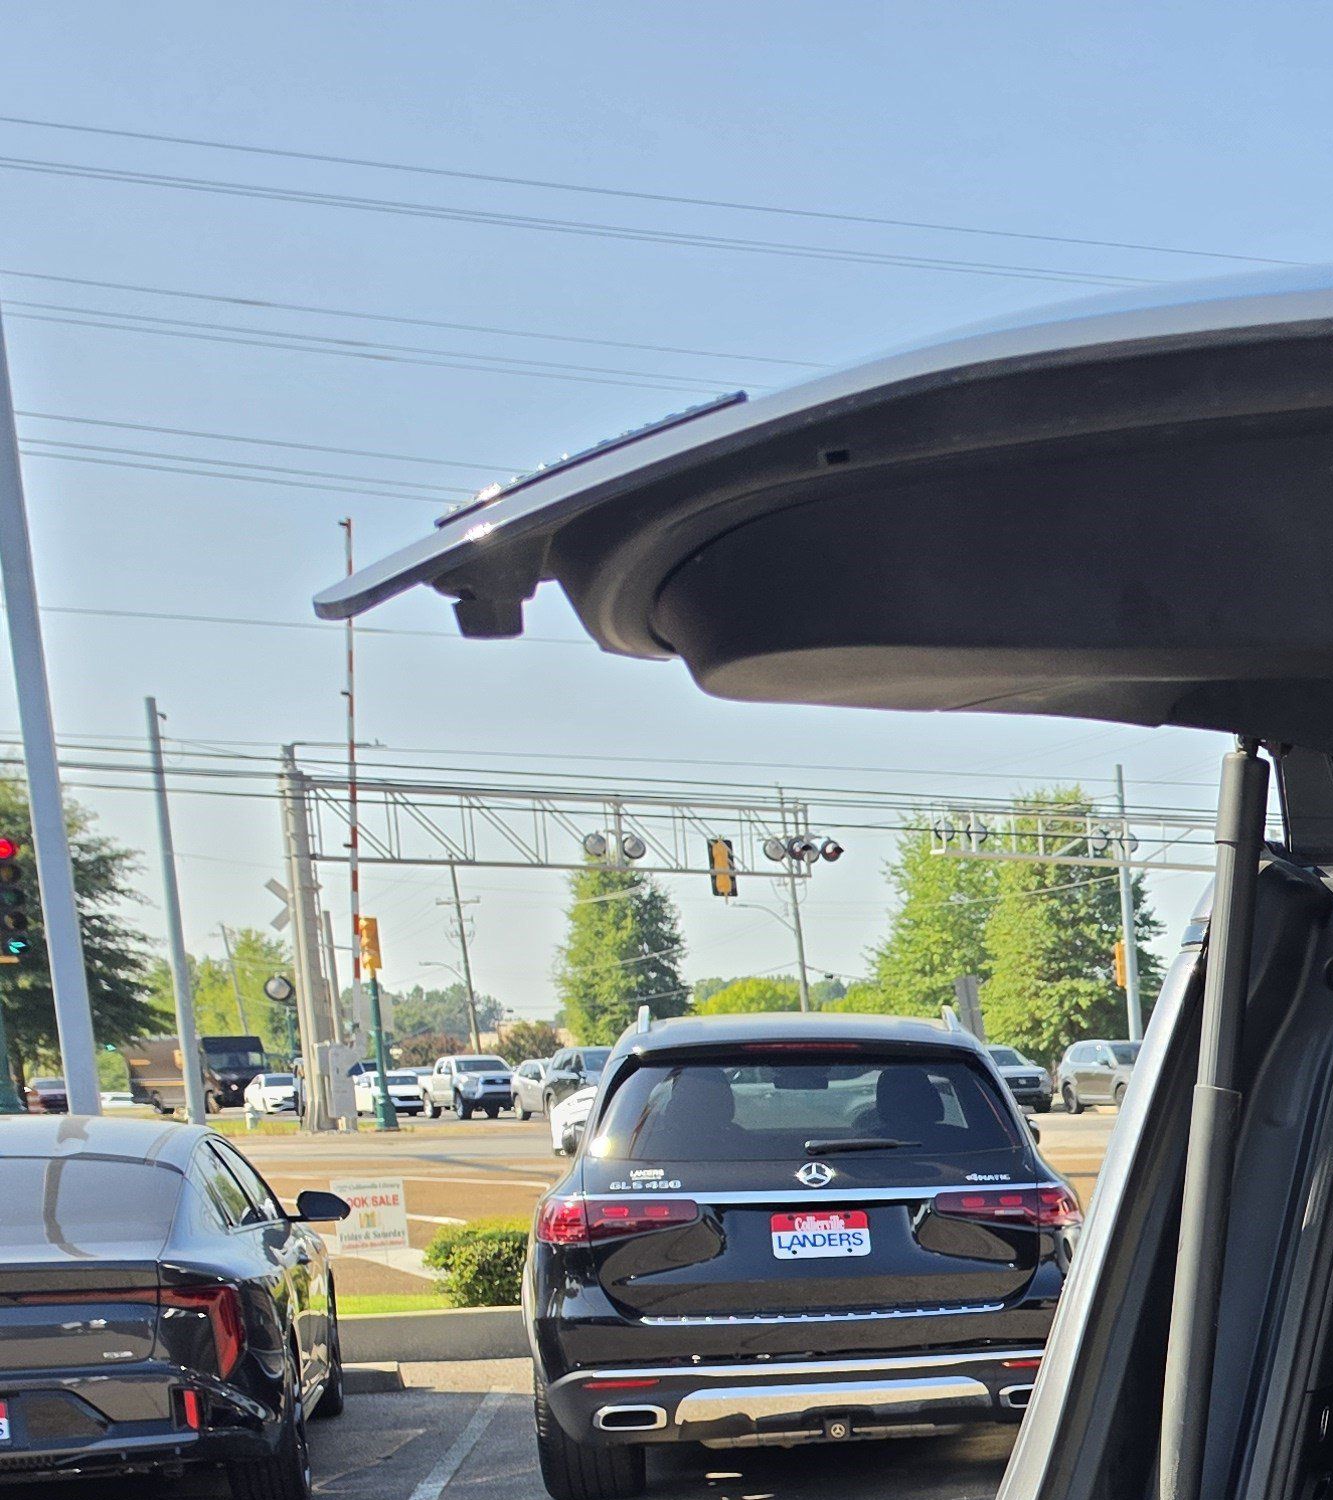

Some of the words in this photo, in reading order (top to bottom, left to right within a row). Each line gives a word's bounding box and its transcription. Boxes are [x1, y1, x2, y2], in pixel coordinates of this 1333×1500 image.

[371, 1194, 399, 1206] SALE
[795, 1215, 845, 1231] Collierville
[777, 1232, 864, 1250] LANDERS
